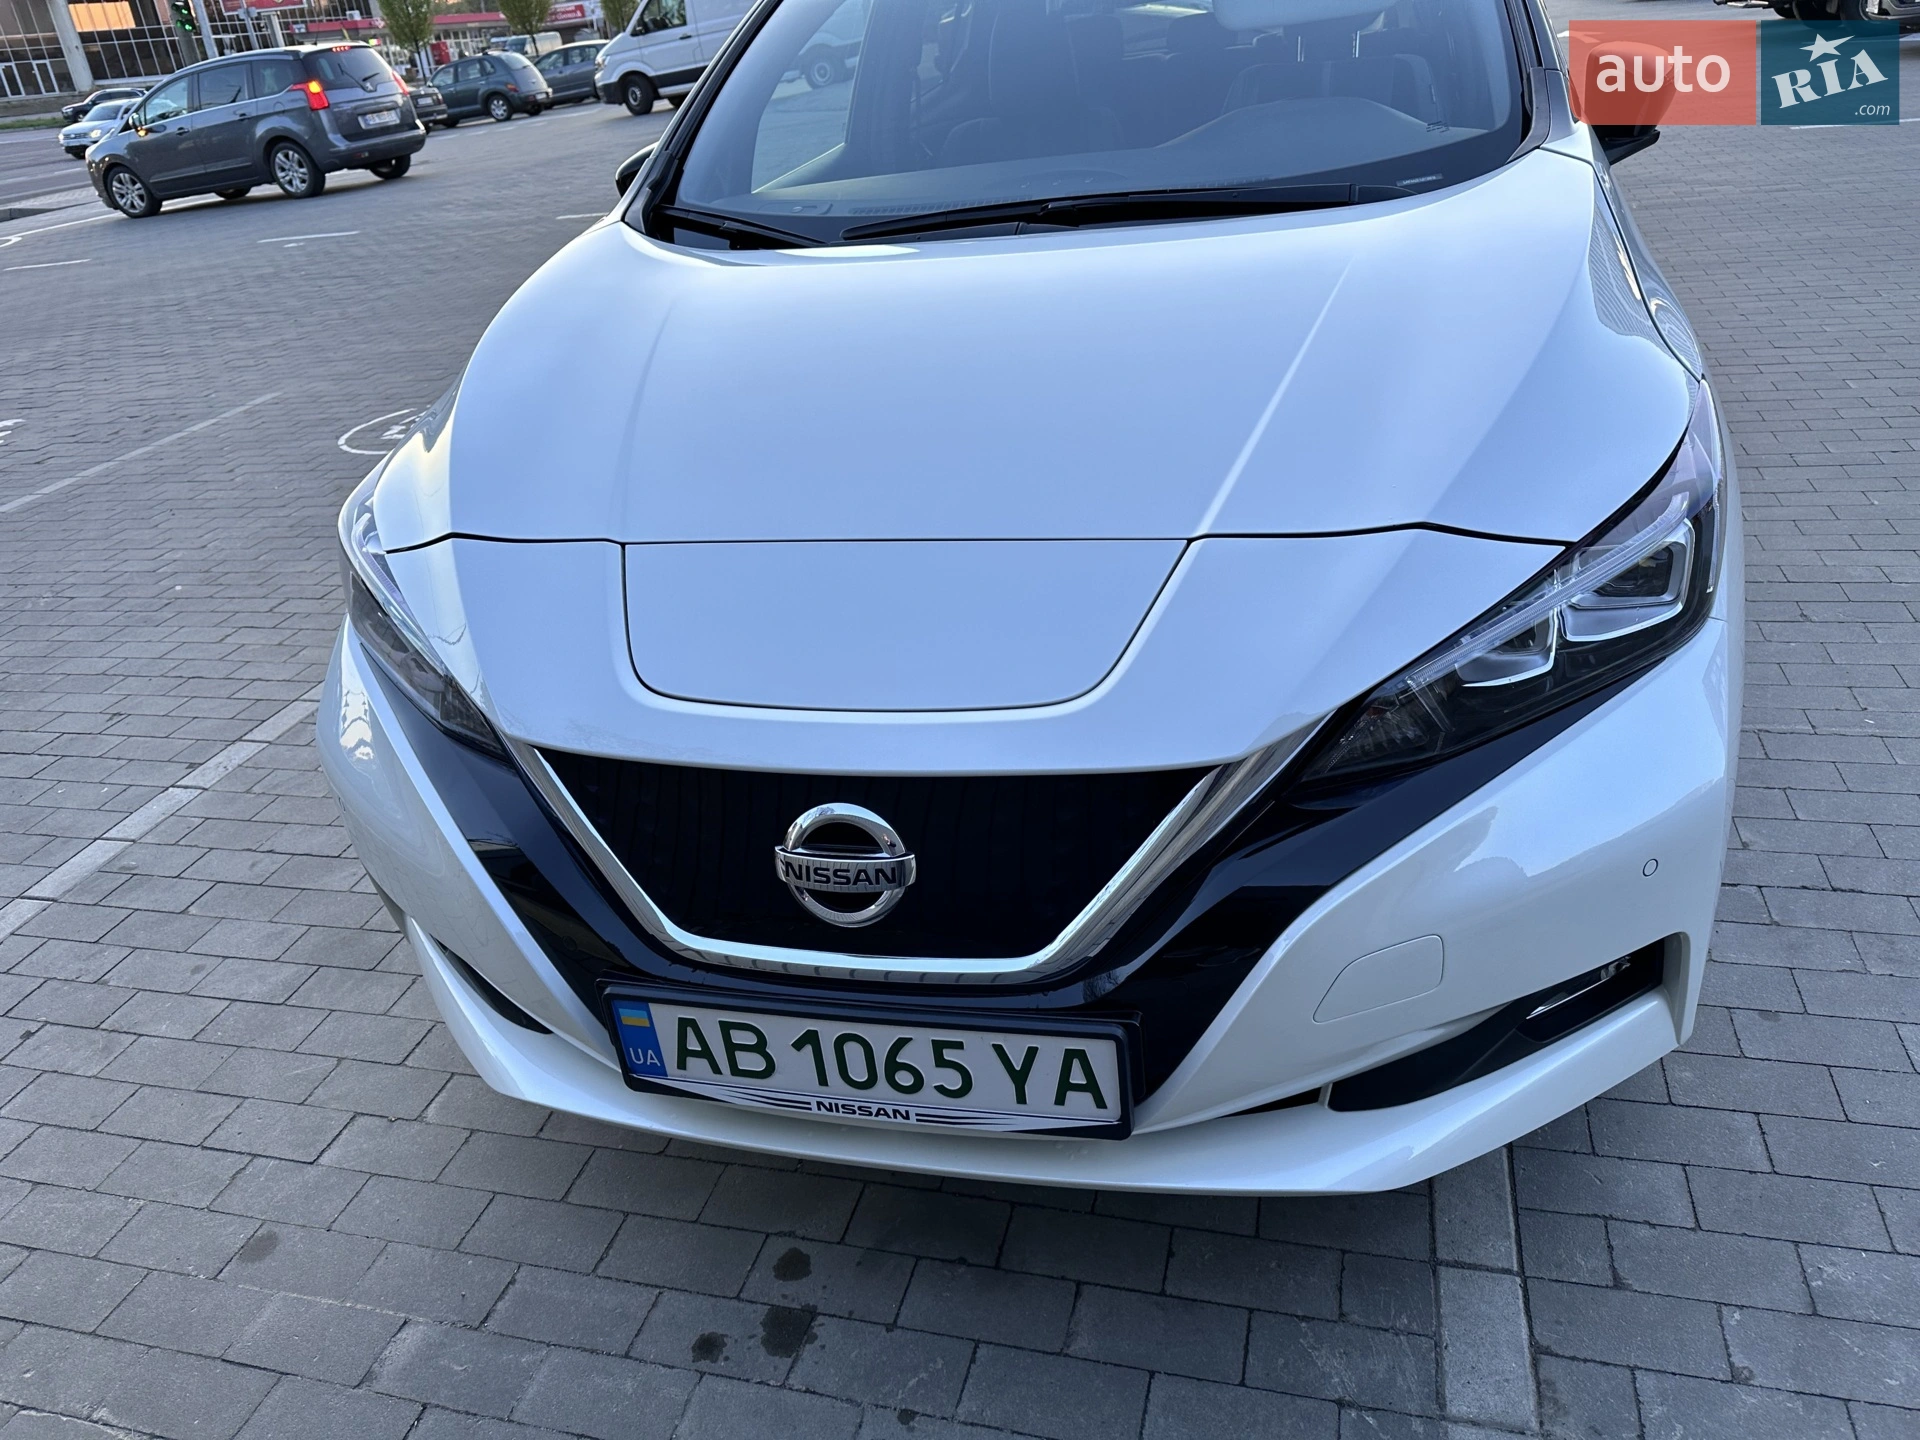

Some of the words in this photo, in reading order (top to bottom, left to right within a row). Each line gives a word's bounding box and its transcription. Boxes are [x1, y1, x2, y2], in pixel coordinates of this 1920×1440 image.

[785, 860, 897, 886] NISSAN
[629, 1047, 661, 1067] UA
[676, 1016, 777, 1080] AB
[790, 1028, 974, 1099] 1065
[991, 1042, 1108, 1110] YA
[815, 1100, 911, 1121] NISSAN
